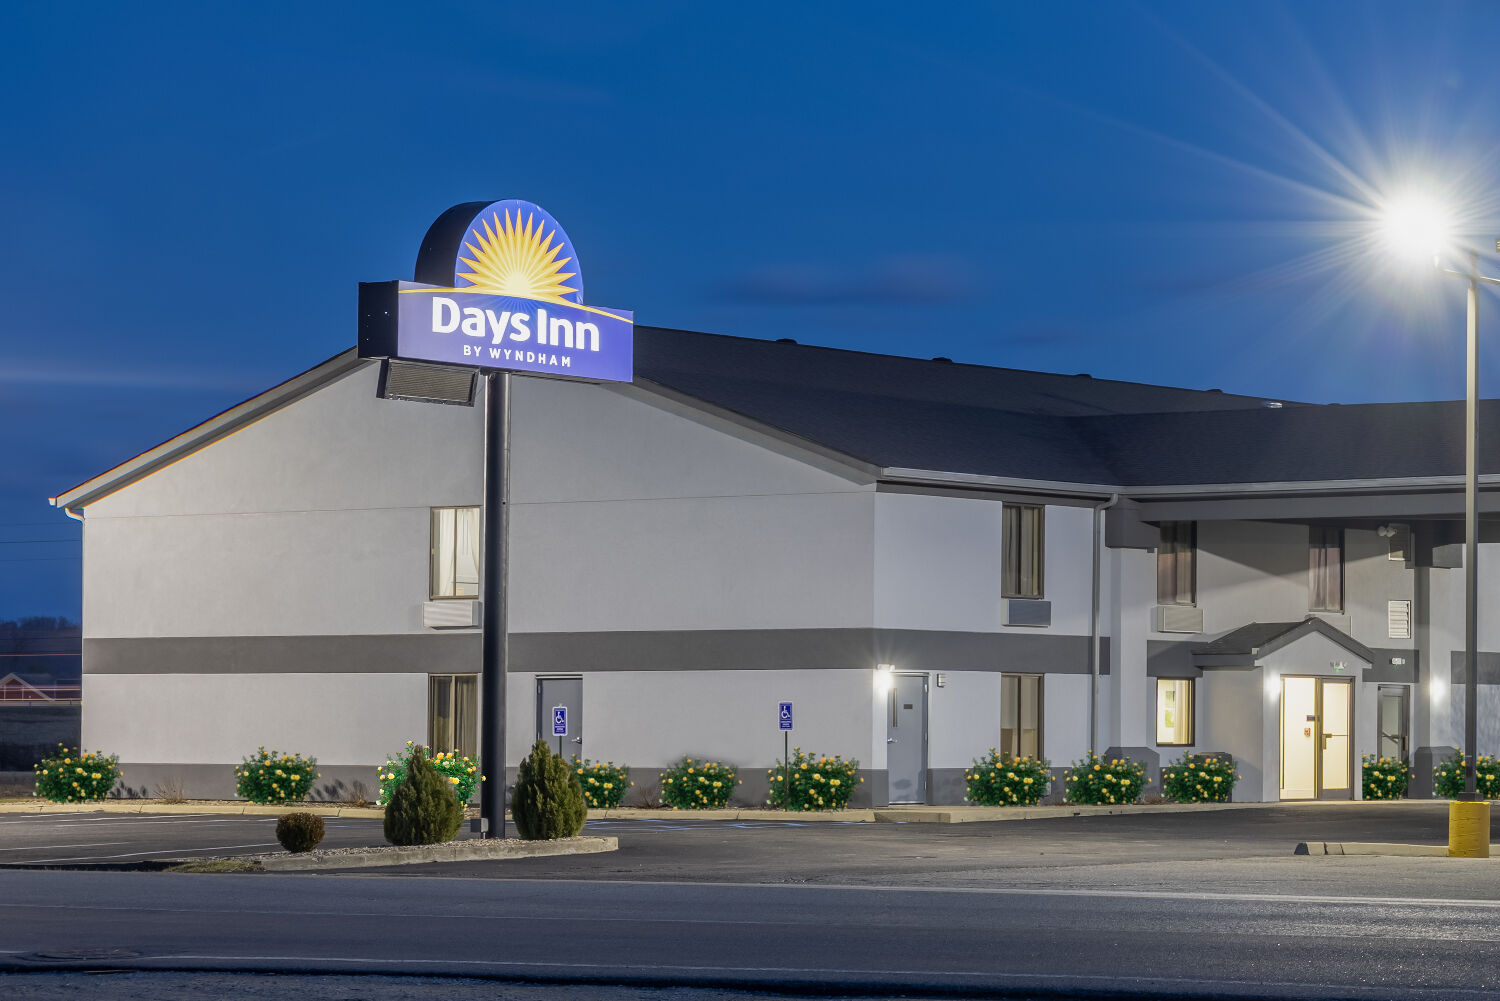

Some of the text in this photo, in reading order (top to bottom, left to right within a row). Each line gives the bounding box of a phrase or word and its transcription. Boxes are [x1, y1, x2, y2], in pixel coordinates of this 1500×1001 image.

[431, 296, 600, 352] Days Inn
[463, 344, 571, 368] BY WYNDHAM
